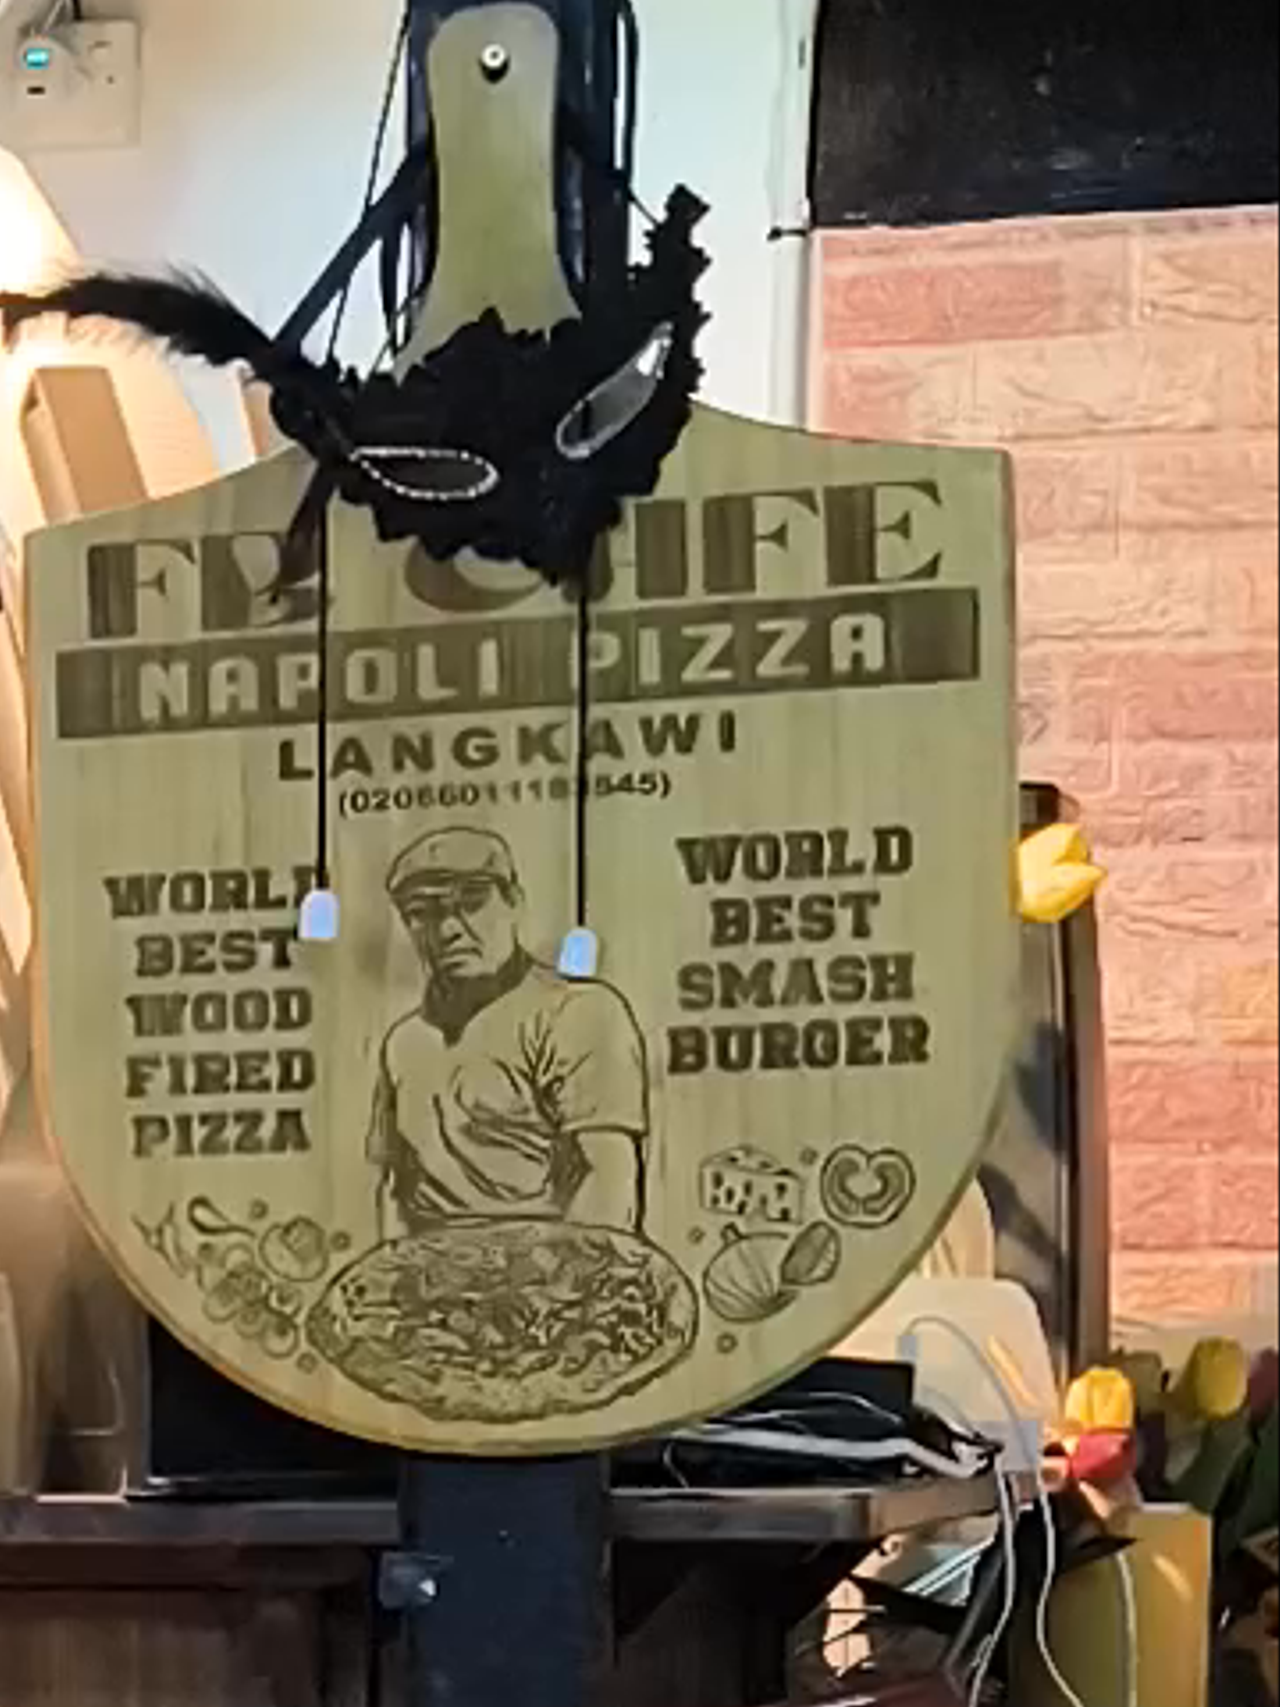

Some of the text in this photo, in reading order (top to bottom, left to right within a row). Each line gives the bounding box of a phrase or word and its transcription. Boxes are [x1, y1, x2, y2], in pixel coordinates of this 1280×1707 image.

[138, 613, 887, 720] NAPOLI PIZZA
[278, 711, 738, 782] LANGKAWI
[675, 825, 913, 885] WORLD
[710, 890, 881, 948] BEST
[135, 927, 299, 978] BEST
[677, 952, 914, 1012] SMASH
[125, 987, 312, 1037] WOOD
[126, 1048, 316, 1099] FIRED
[667, 1014, 930, 1076] BURGER
[131, 1108, 313, 1159] PIZZA
